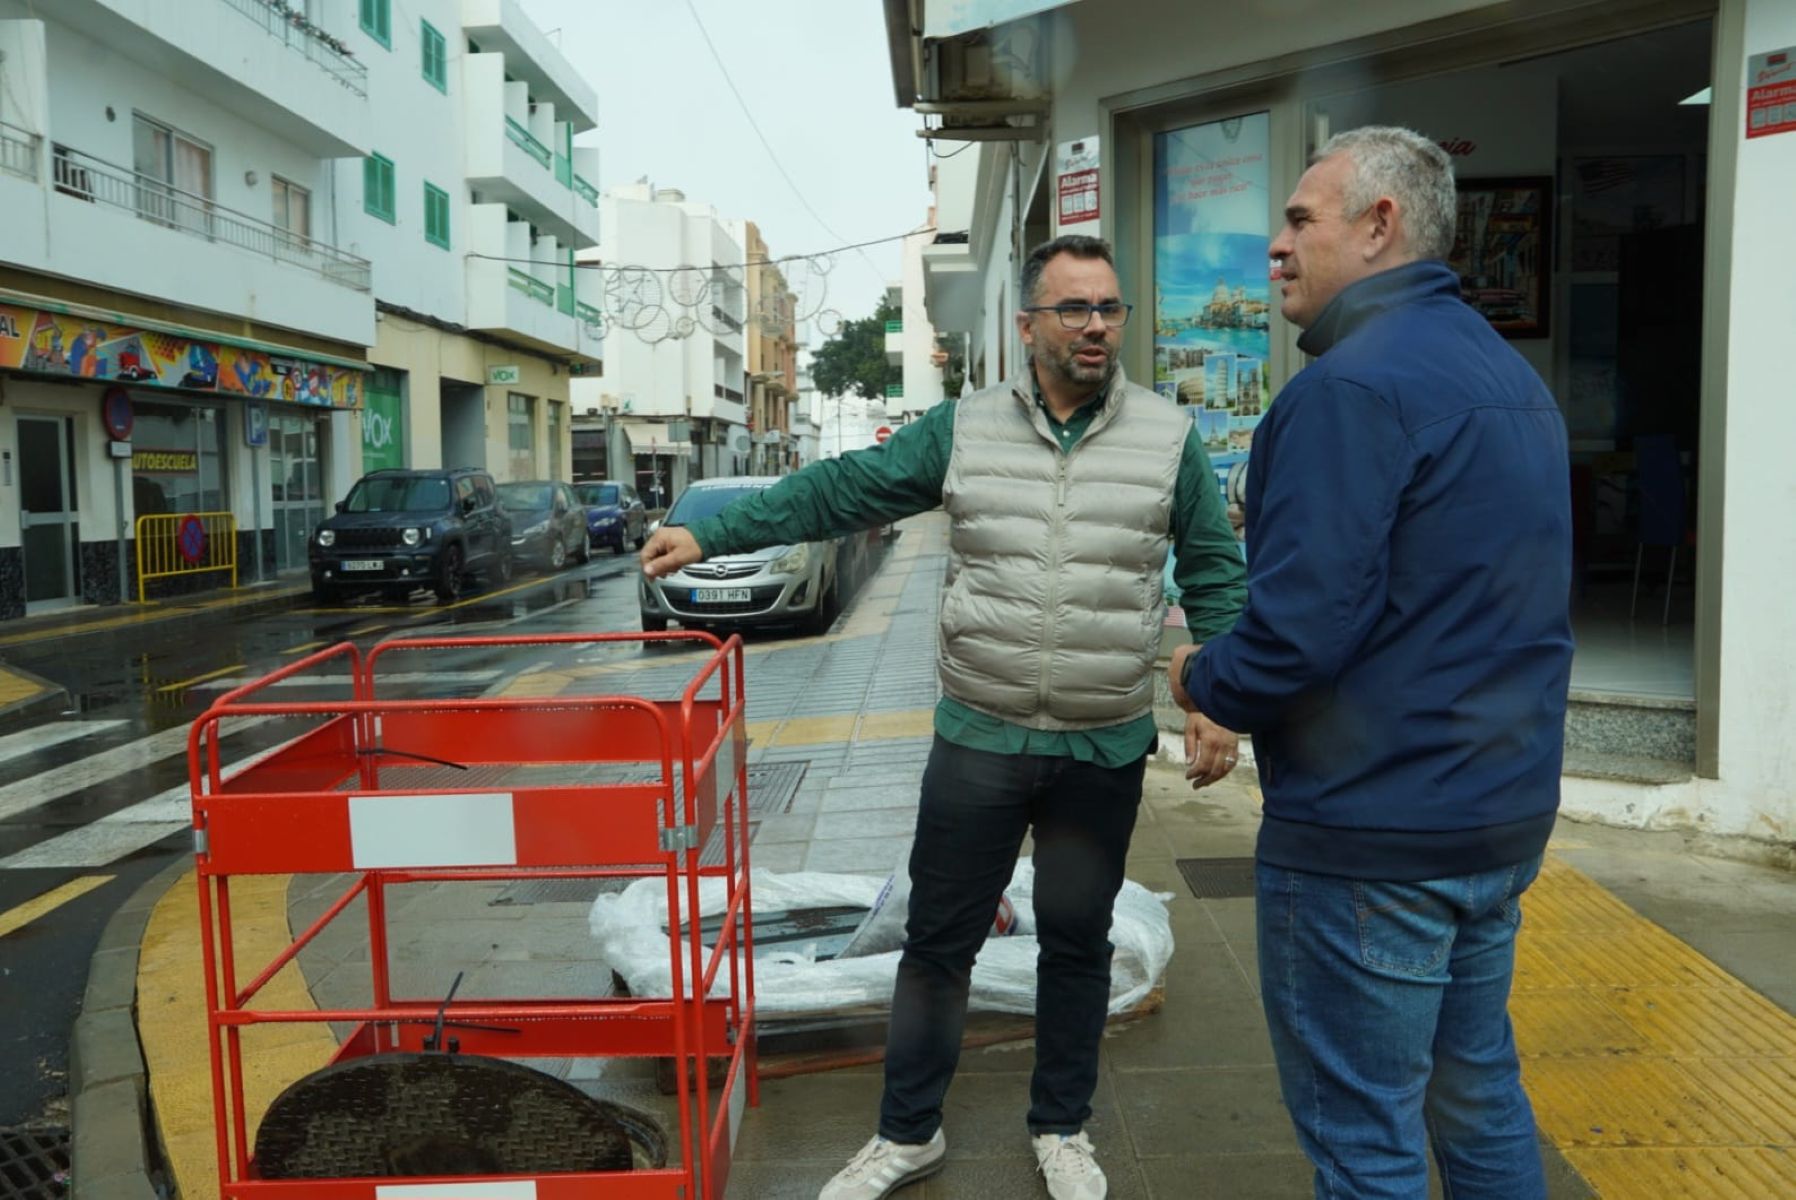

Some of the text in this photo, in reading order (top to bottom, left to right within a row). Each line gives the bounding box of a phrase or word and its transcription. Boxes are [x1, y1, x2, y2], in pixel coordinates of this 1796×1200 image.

[1061, 172, 1098, 189] Alarma
[493, 369, 516, 382] VOX
[251, 407, 261, 441] P
[363, 408, 393, 449] VOX
[699, 588, 749, 600] 0391 HFN
